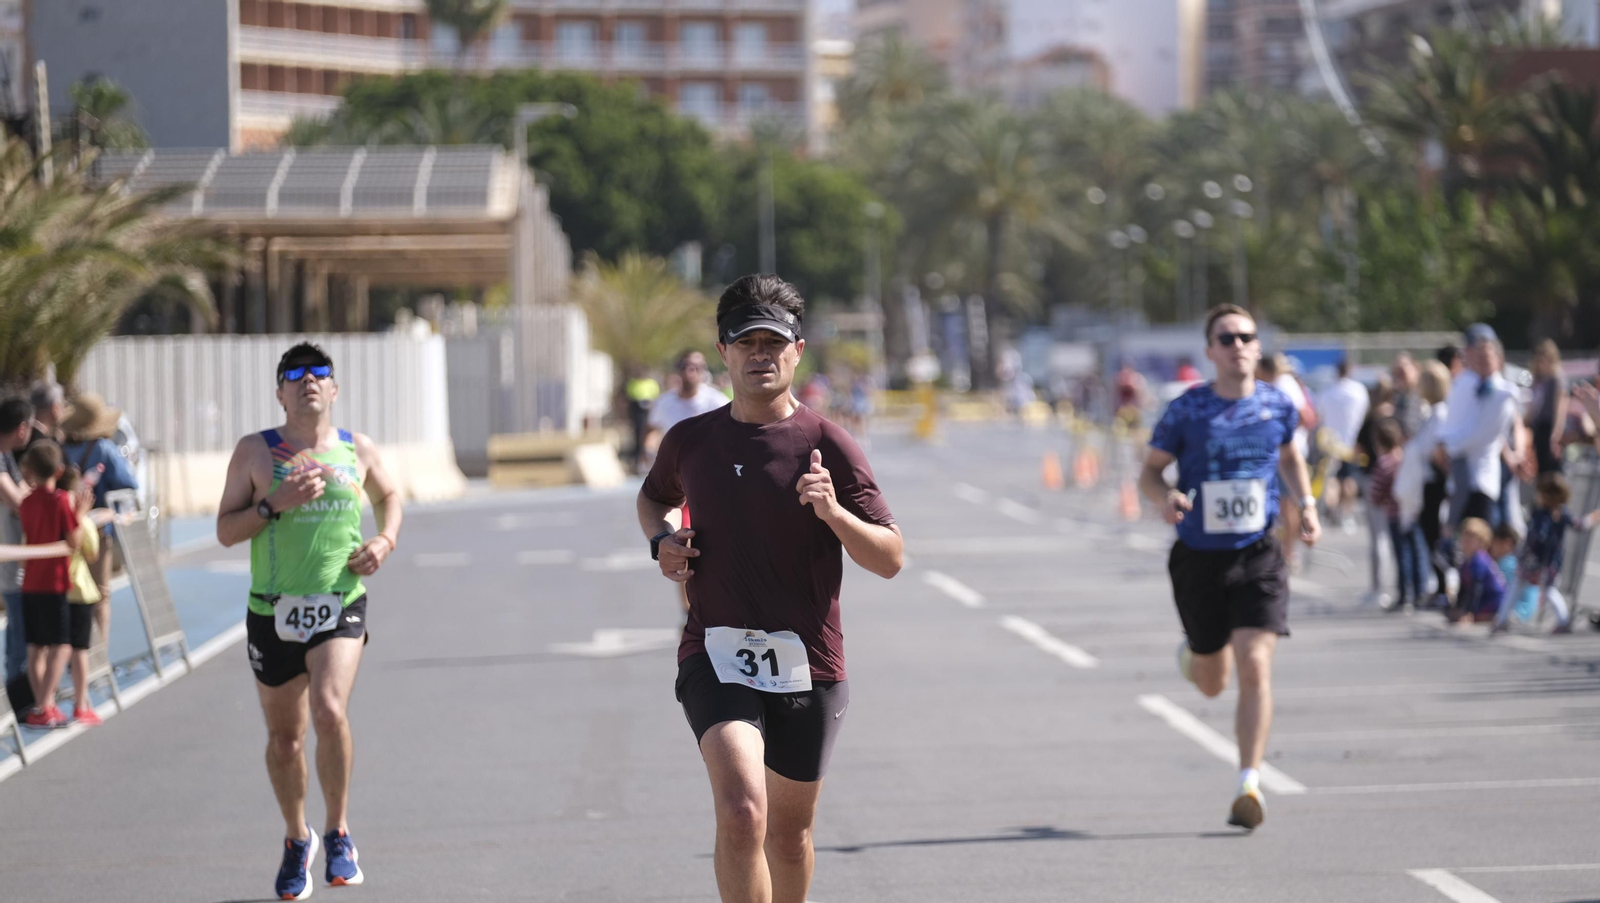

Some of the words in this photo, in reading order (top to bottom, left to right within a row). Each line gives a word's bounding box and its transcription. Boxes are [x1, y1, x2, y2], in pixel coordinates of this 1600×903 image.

[301, 498, 354, 512] SAKATA
[1214, 495, 1258, 519] 300
[285, 604, 331, 630] 459
[736, 648, 779, 678] 31
